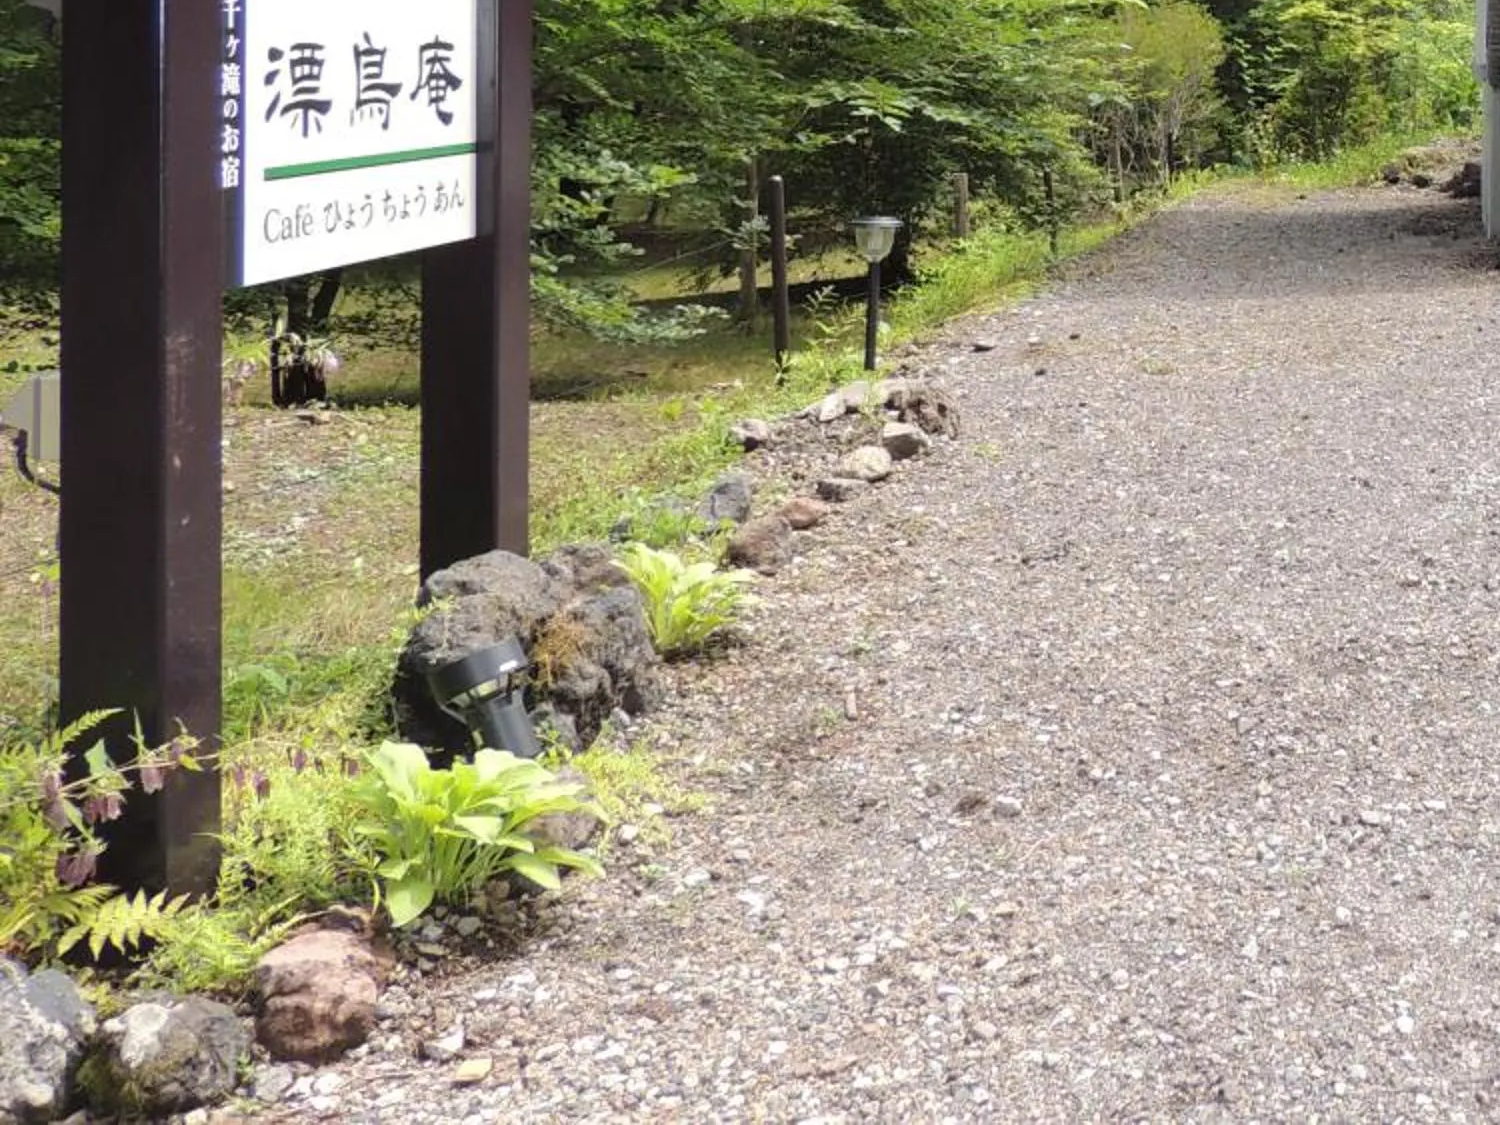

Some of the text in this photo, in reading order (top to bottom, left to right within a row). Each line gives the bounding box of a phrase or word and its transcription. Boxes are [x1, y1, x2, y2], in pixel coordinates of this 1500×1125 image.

[264, 31, 463, 138] 漂鳥庵
[263, 177, 465, 244] Café ひょうちょうあん
